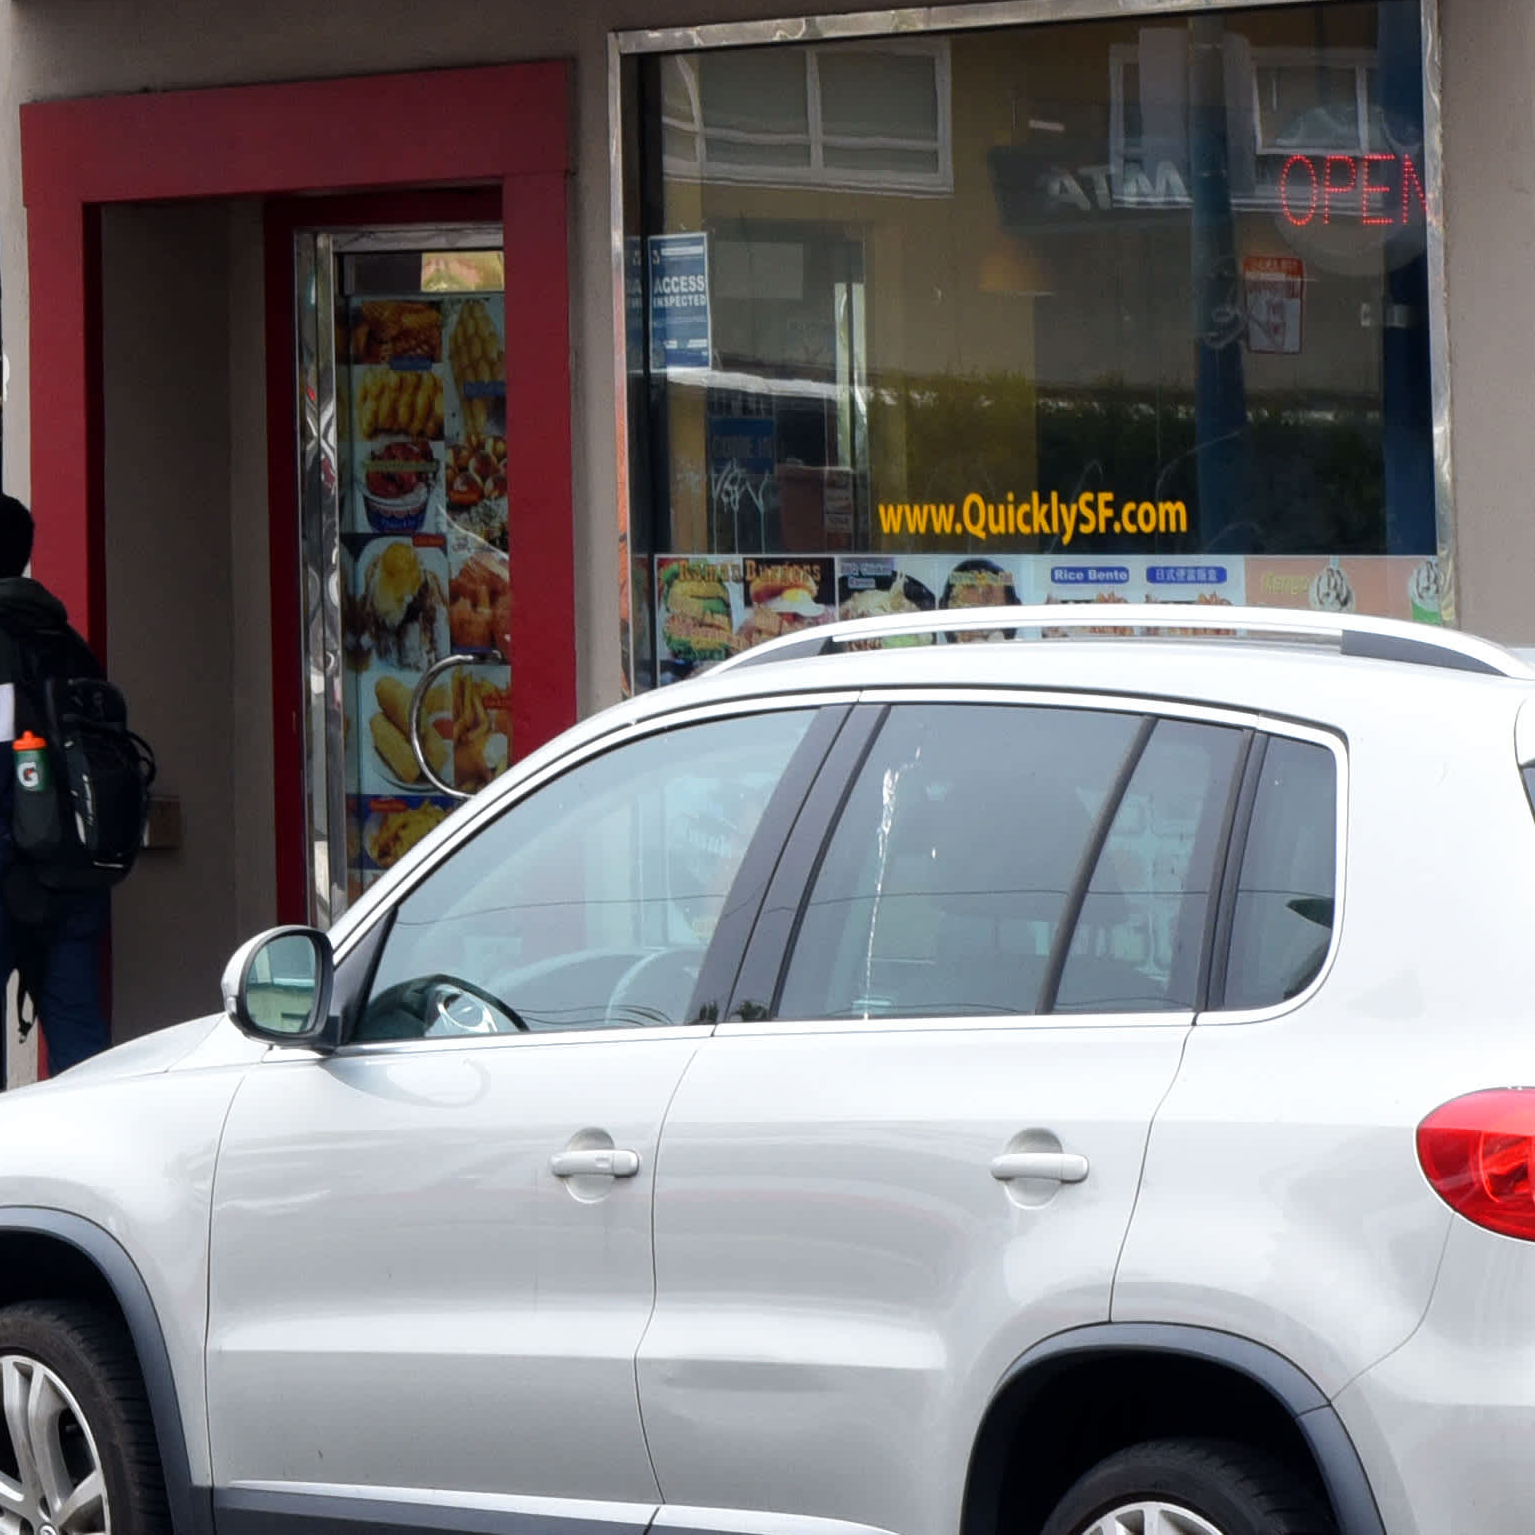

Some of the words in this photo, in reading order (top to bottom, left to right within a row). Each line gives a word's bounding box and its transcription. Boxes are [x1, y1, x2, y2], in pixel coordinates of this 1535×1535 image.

[1281, 153, 1429, 227] OPEN
[653, 274, 705, 294] ACCESS
[653, 295, 706, 308] INSPECTED
[878, 490, 1188, 546] www.QuicklySF.com
[1053, 569, 1084, 581] Rice
[1088, 569, 1128, 581] Bento
[17, 761, 40, 788] G
